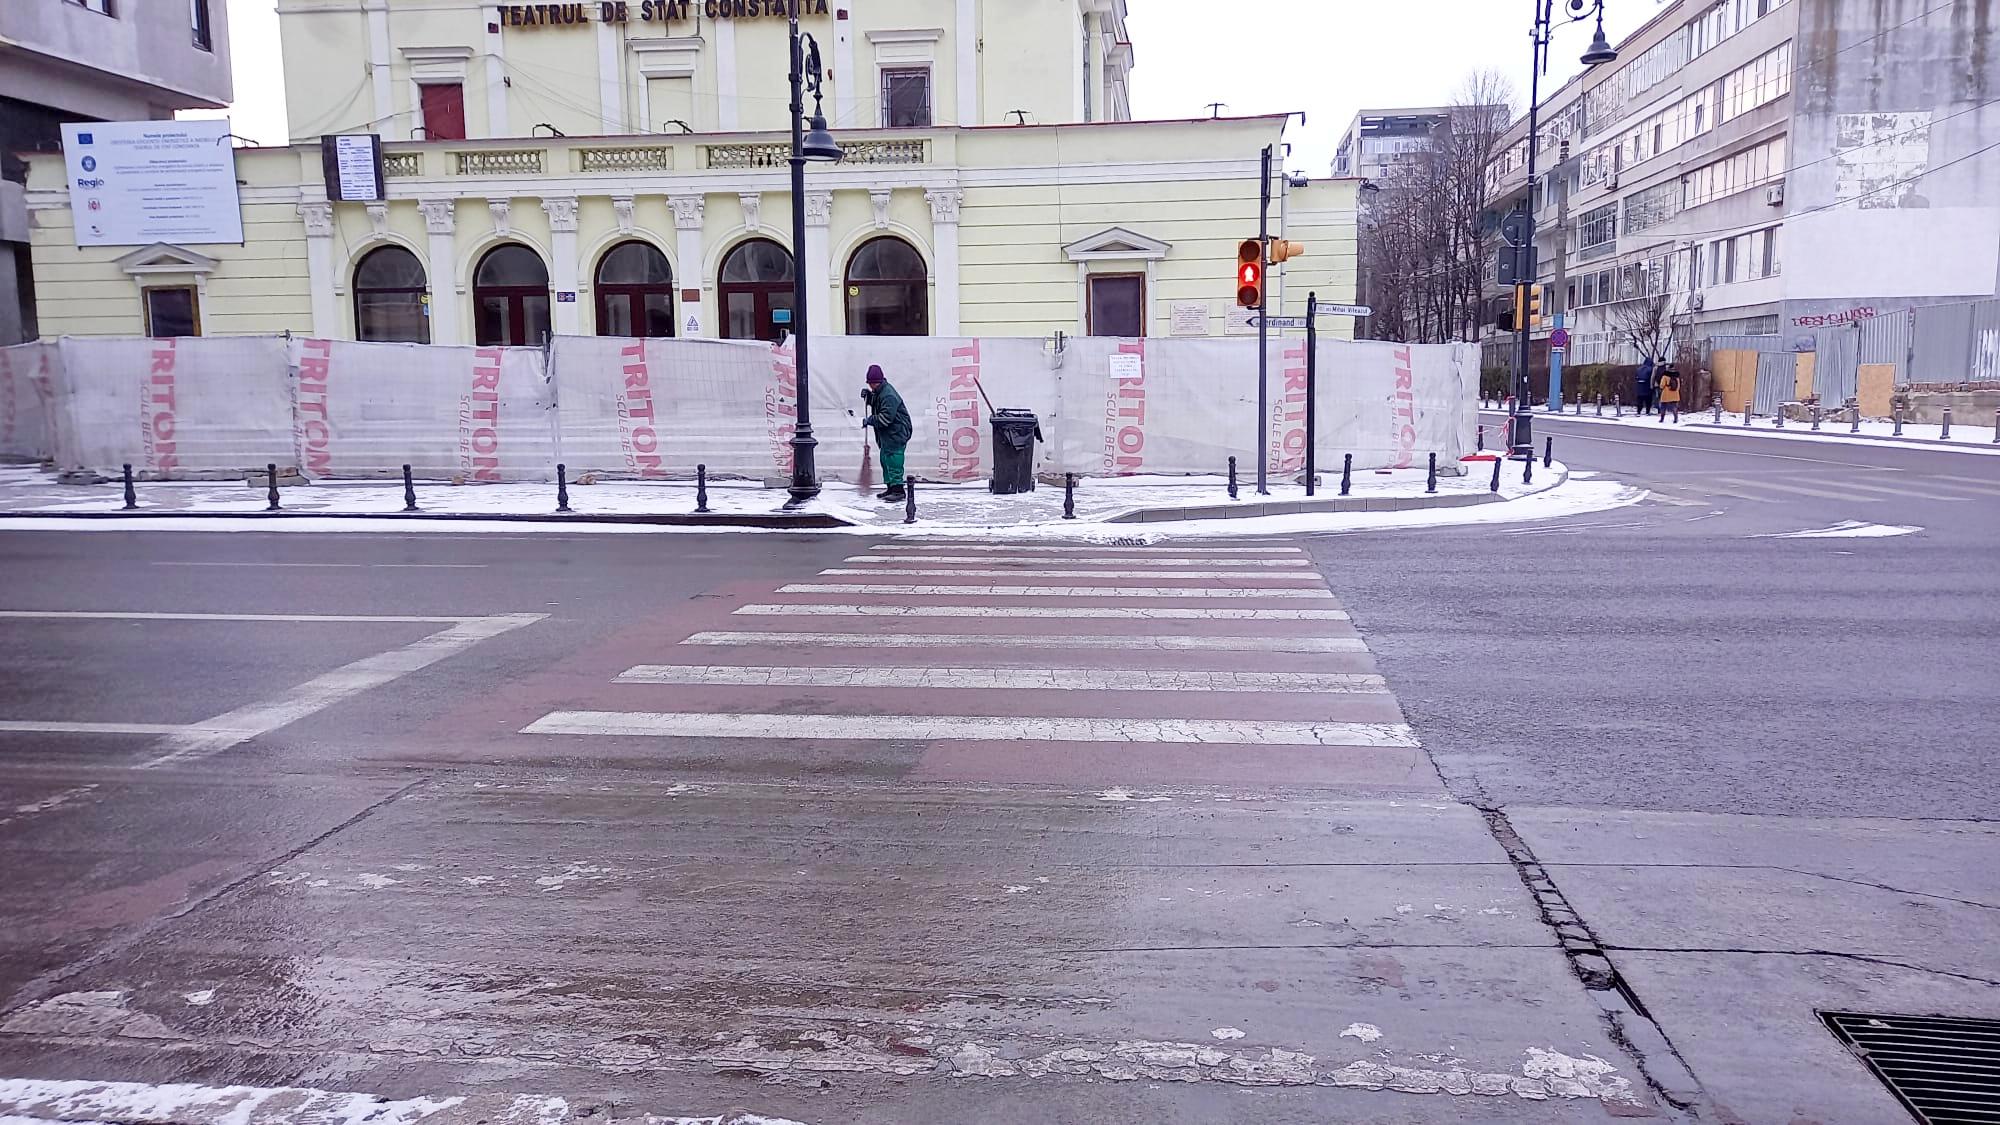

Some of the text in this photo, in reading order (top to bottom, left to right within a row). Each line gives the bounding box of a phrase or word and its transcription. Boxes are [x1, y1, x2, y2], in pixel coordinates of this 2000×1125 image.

[498, 3, 588, 26] TEATRUL
[602, 1, 627, 22] DE
[641, 0, 690, 20] STAT
[78, 178, 104, 188] Regio
[1266, 318, 1294, 327] erdinand
[151, 337, 178, 472] TRITON
[300, 339, 331, 476] TRITON
[459, 395, 470, 433] SCULE
[472, 348, 502, 480] TRITON
[616, 394, 630, 433] SCULE
[621, 339, 662, 477] TRITON
[936, 396, 950, 477] SCULE BETON
[950, 338, 979, 479] TRITON
[1105, 392, 1117, 432] SCULE
[1270, 400, 1283, 474] SCULE BETO
